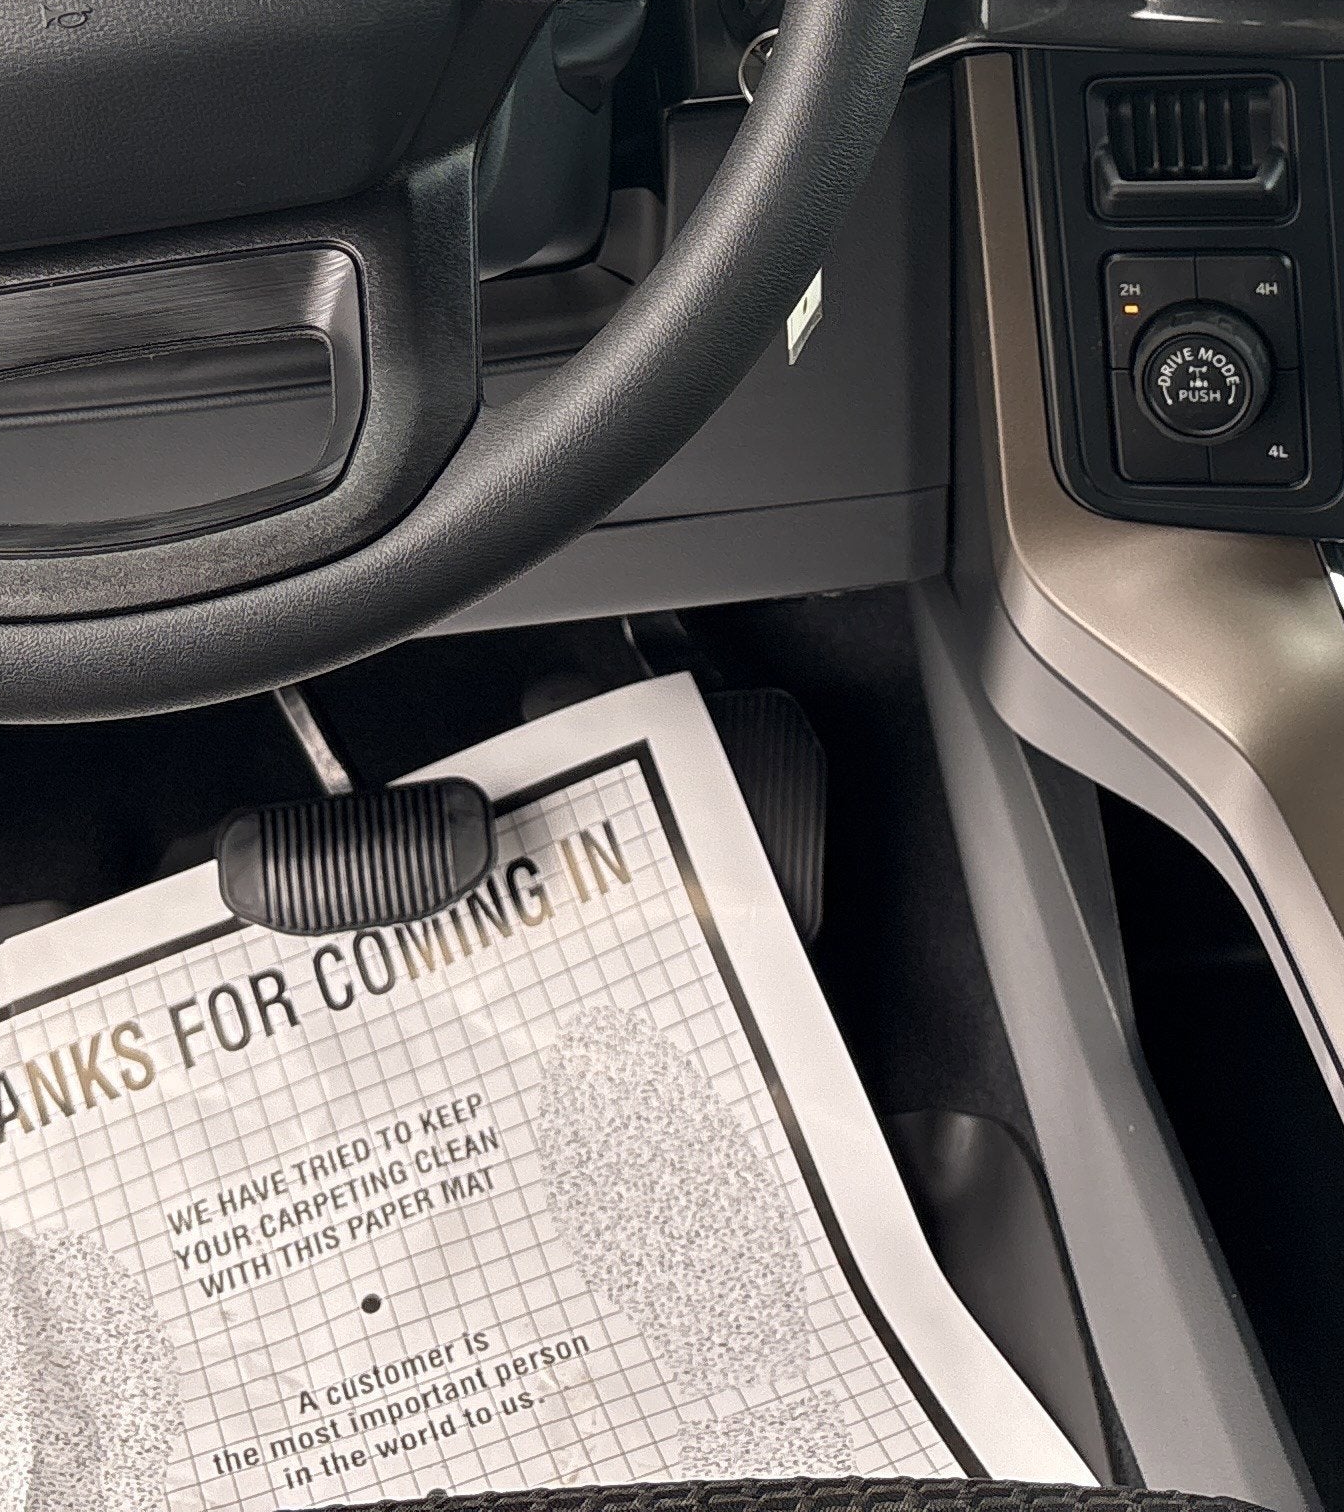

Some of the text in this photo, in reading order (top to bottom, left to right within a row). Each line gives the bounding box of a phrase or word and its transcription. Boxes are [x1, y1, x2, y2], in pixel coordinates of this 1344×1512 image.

[1120, 283, 1141, 297] 2H
[1256, 282, 1278, 296] 4H
[1158, 347, 1240, 387] DRIVE MODE
[1178, 389, 1221, 403] PUSH
[1268, 445, 1289, 459] 4L
[169, 968, 300, 1069] FOR
[313, 856, 555, 1011] COMING
[560, 821, 632, 904] IN
[167, 1092, 483, 1235] WE HAVE TRIED TO KEEP
[173, 1126, 500, 1271] YOUR CARPETING CLEAN
[199, 1165, 498, 1297] WITH THIS PAPER MAT
[212, 1334, 590, 1475] the most important person
[298, 1331, 489, 1414] A customer is
[283, 1391, 547, 1489] in the world to us.
